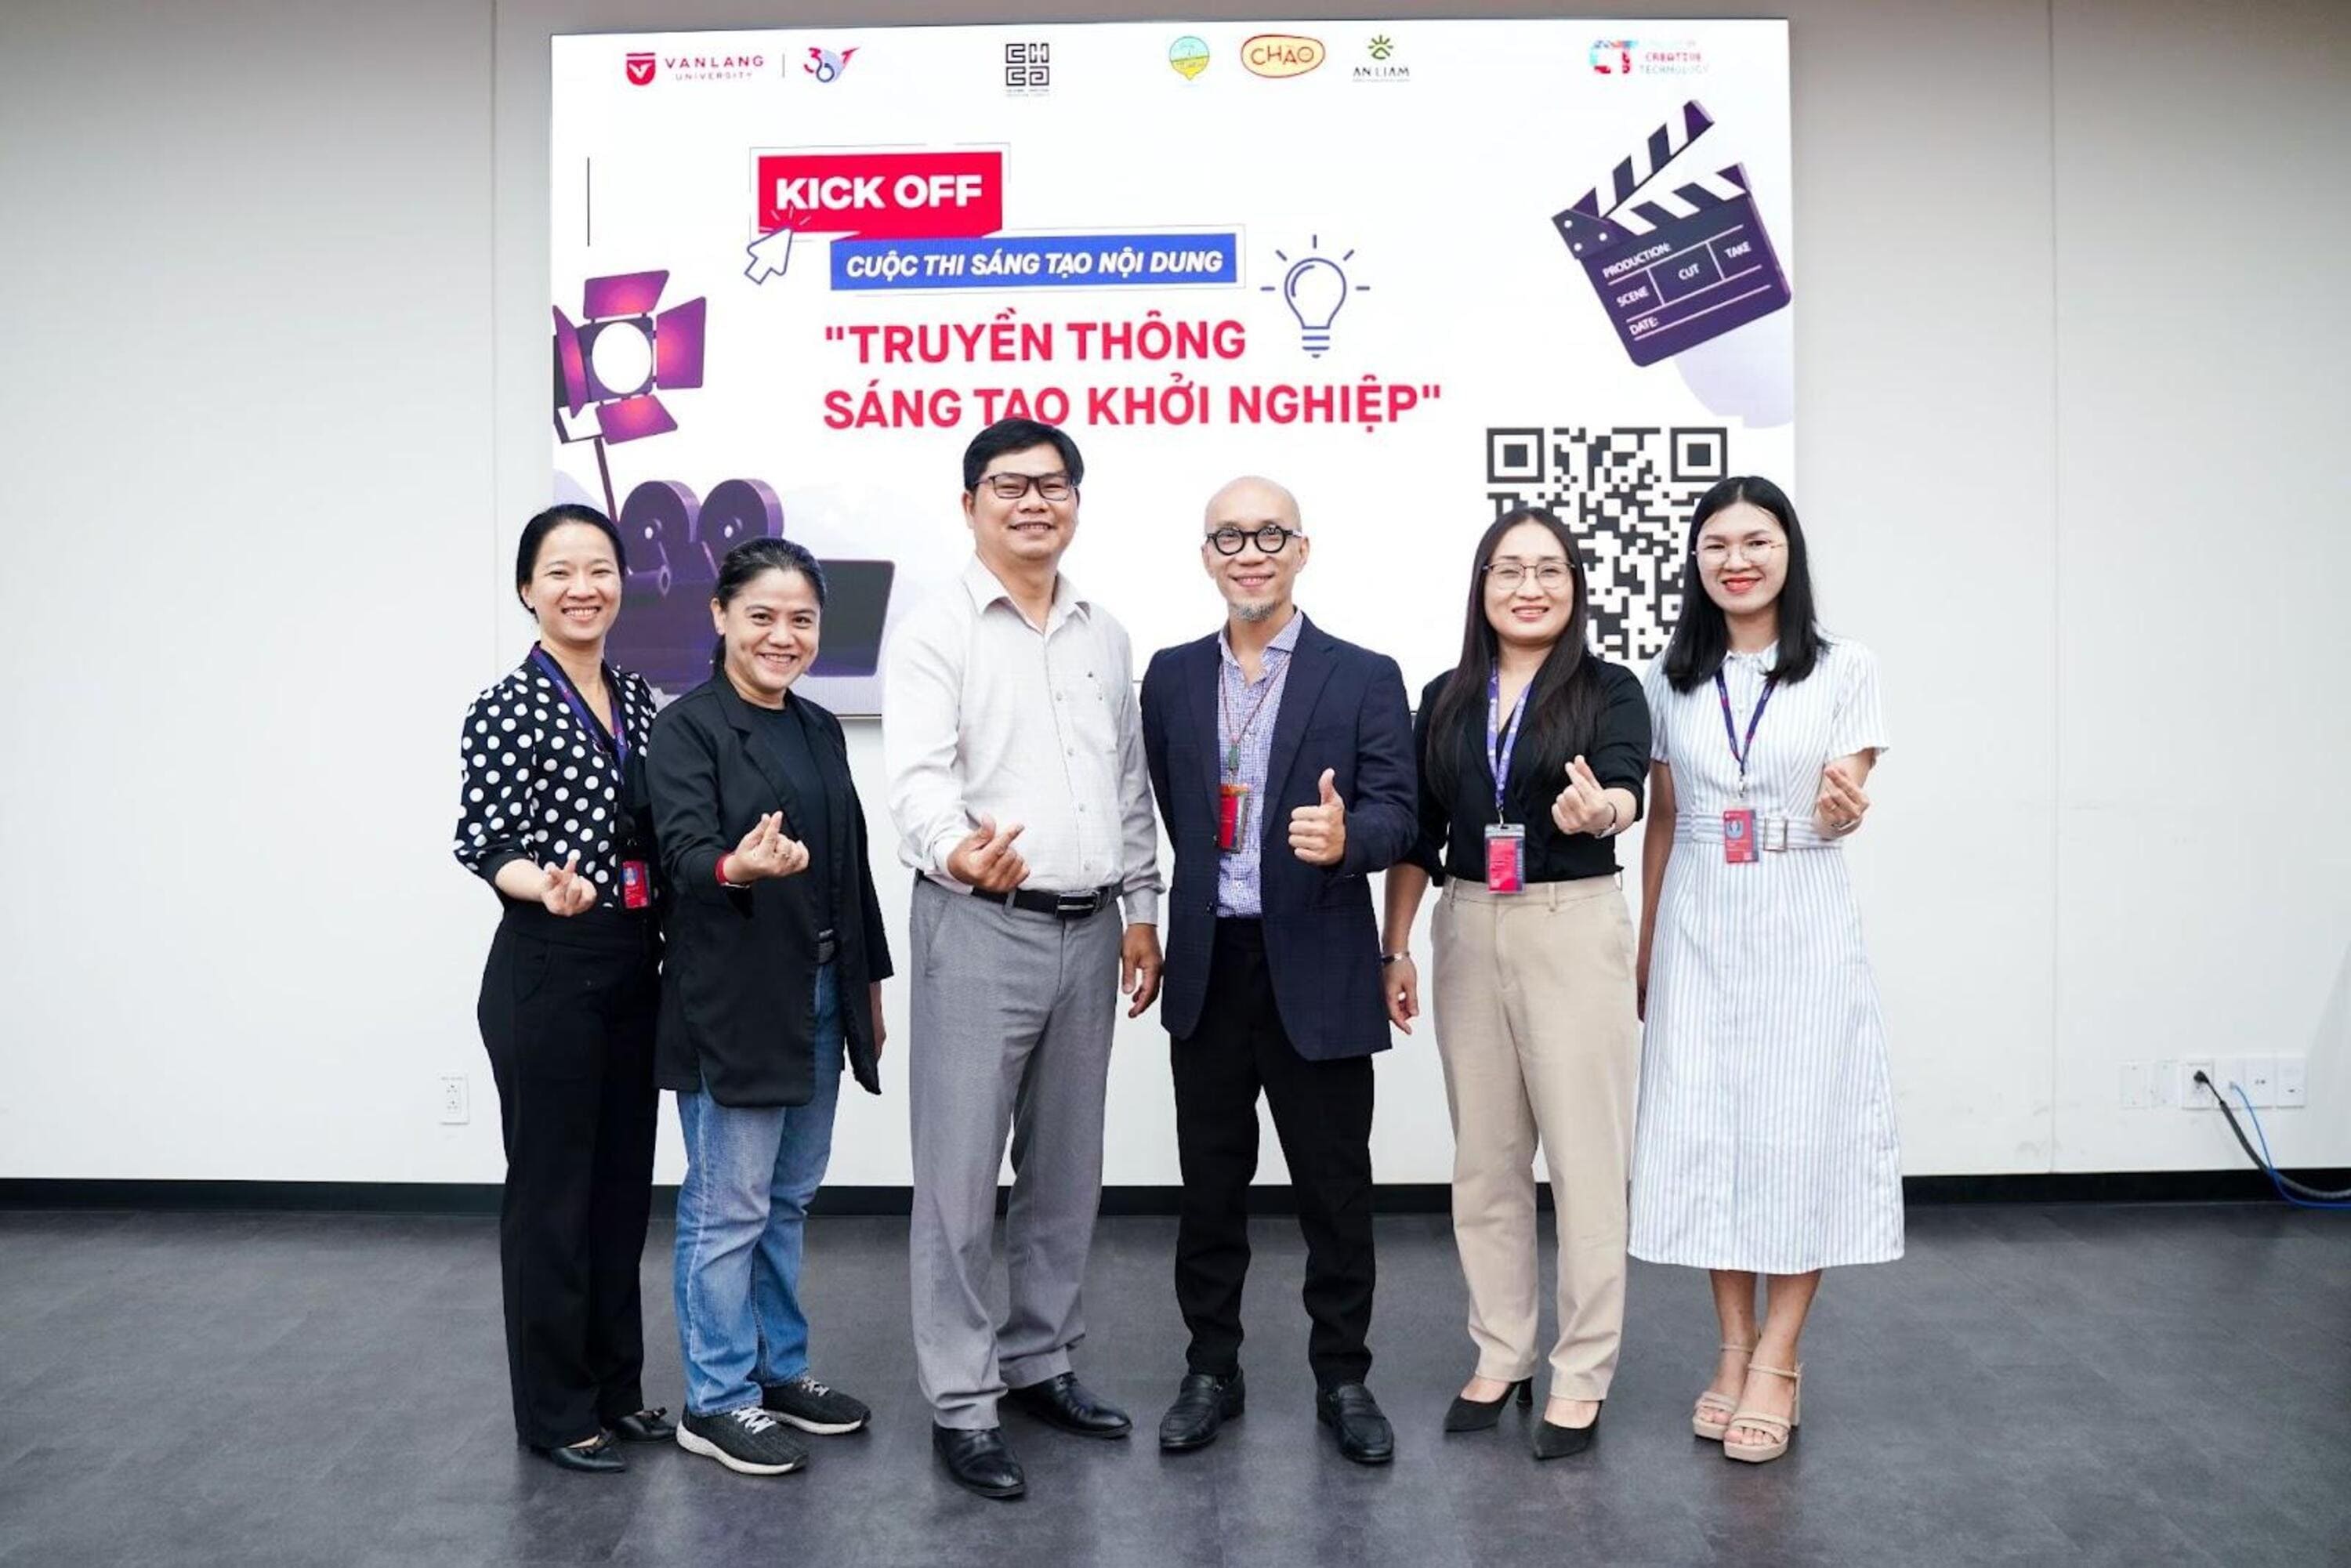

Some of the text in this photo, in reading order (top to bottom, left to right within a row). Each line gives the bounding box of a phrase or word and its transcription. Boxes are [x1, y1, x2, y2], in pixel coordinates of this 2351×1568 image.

[776, 175, 983, 210] KICK OFF
[846, 246, 1223, 282] CUỘC THI SÁNG TẠO NỘI DUNG
[1602, 241, 1672, 278] PRODUCTION:
[1724, 241, 1752, 259] TAKE
[1678, 263, 1701, 281] CUT
[1616, 284, 1650, 308] SCENE
[824, 307, 1246, 364] "TRUYỀN THÔNG
[1628, 316, 1660, 336] DATE:
[824, 378, 962, 429] SÁNG
[1088, 372, 1210, 425] KHỞI
[1230, 374, 1441, 433] NGHIỆP"
